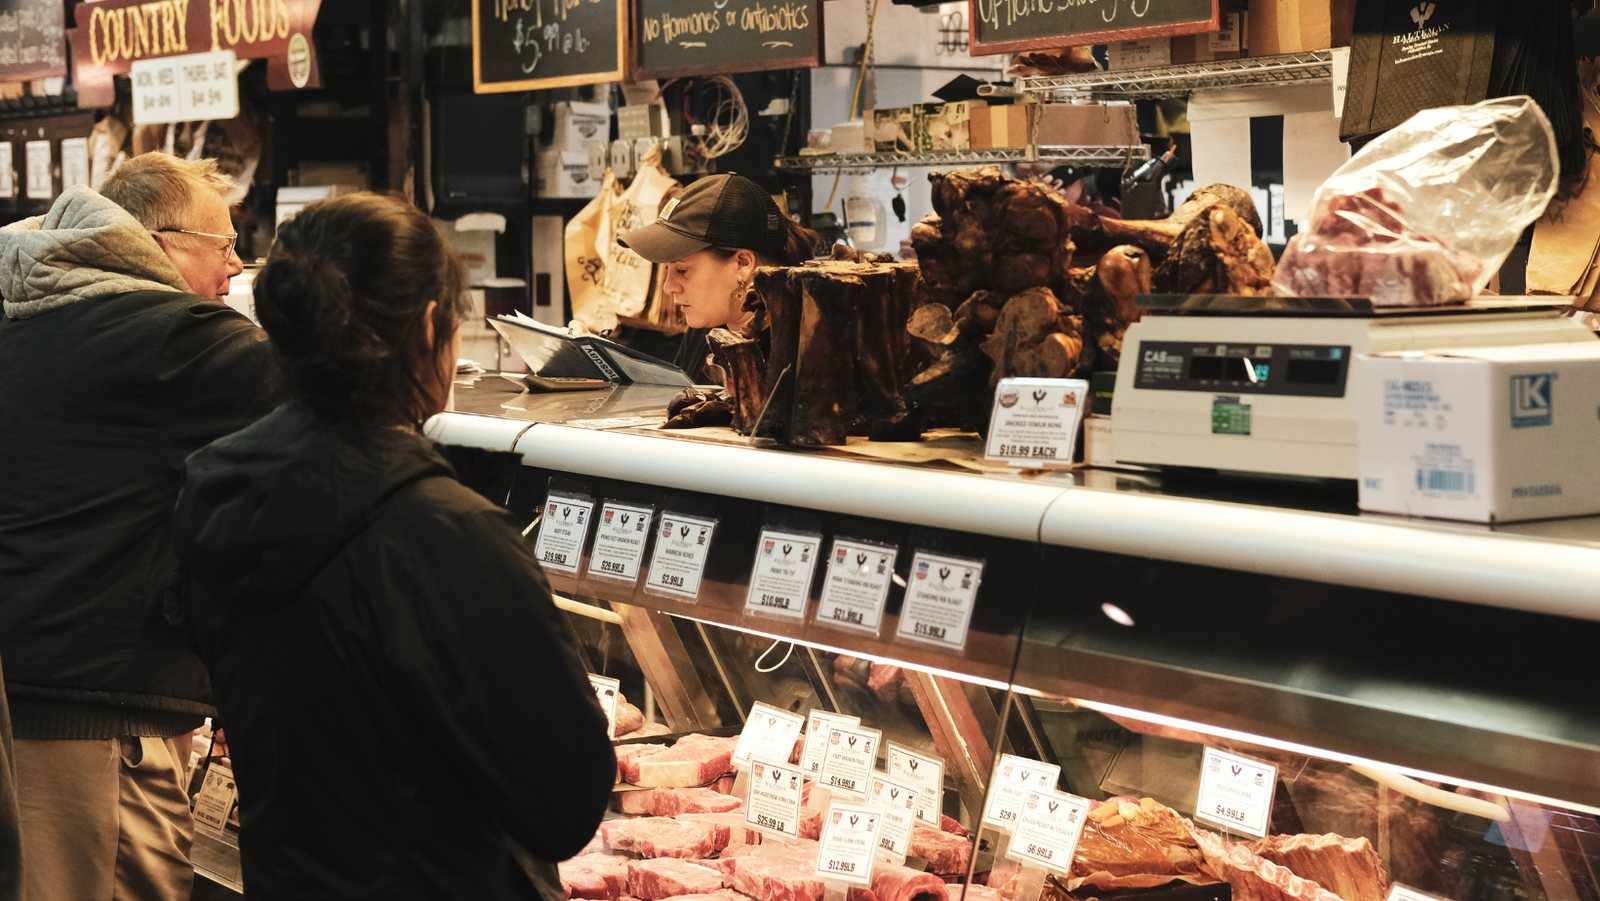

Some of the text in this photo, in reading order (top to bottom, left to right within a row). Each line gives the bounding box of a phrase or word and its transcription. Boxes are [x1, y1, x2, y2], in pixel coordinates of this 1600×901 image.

[89, 1, 189, 68] COUNTRY
[209, 0, 290, 51] FOODS
[642, 18, 661, 43] No
[662, 10, 720, 44] Hormones
[725, 11, 737, 27] or
[1144, 351, 1167, 363] CAS
[999, 444, 1057, 458] $10.99 EACH
[664, 548, 695, 560] MARROW BONES
[600, 559, 626, 574] $29.99LB
[661, 573, 685, 588] $2.99LB
[761, 593, 790, 610] $10.99LB
[833, 606, 864, 625] $21.99LB
[830, 775, 856, 790] $14.99LB
[1216, 783, 1226, 791] BEEF
[1215, 804, 1245, 821] $4.99LB
[757, 814, 785, 832] $25.99 LB
[1022, 816, 1036, 825] CHUCK
[1036, 820, 1050, 829] ROAST
[1027, 843, 1054, 860] $6.99LB
[828, 859, 856, 873] $12.99LB
